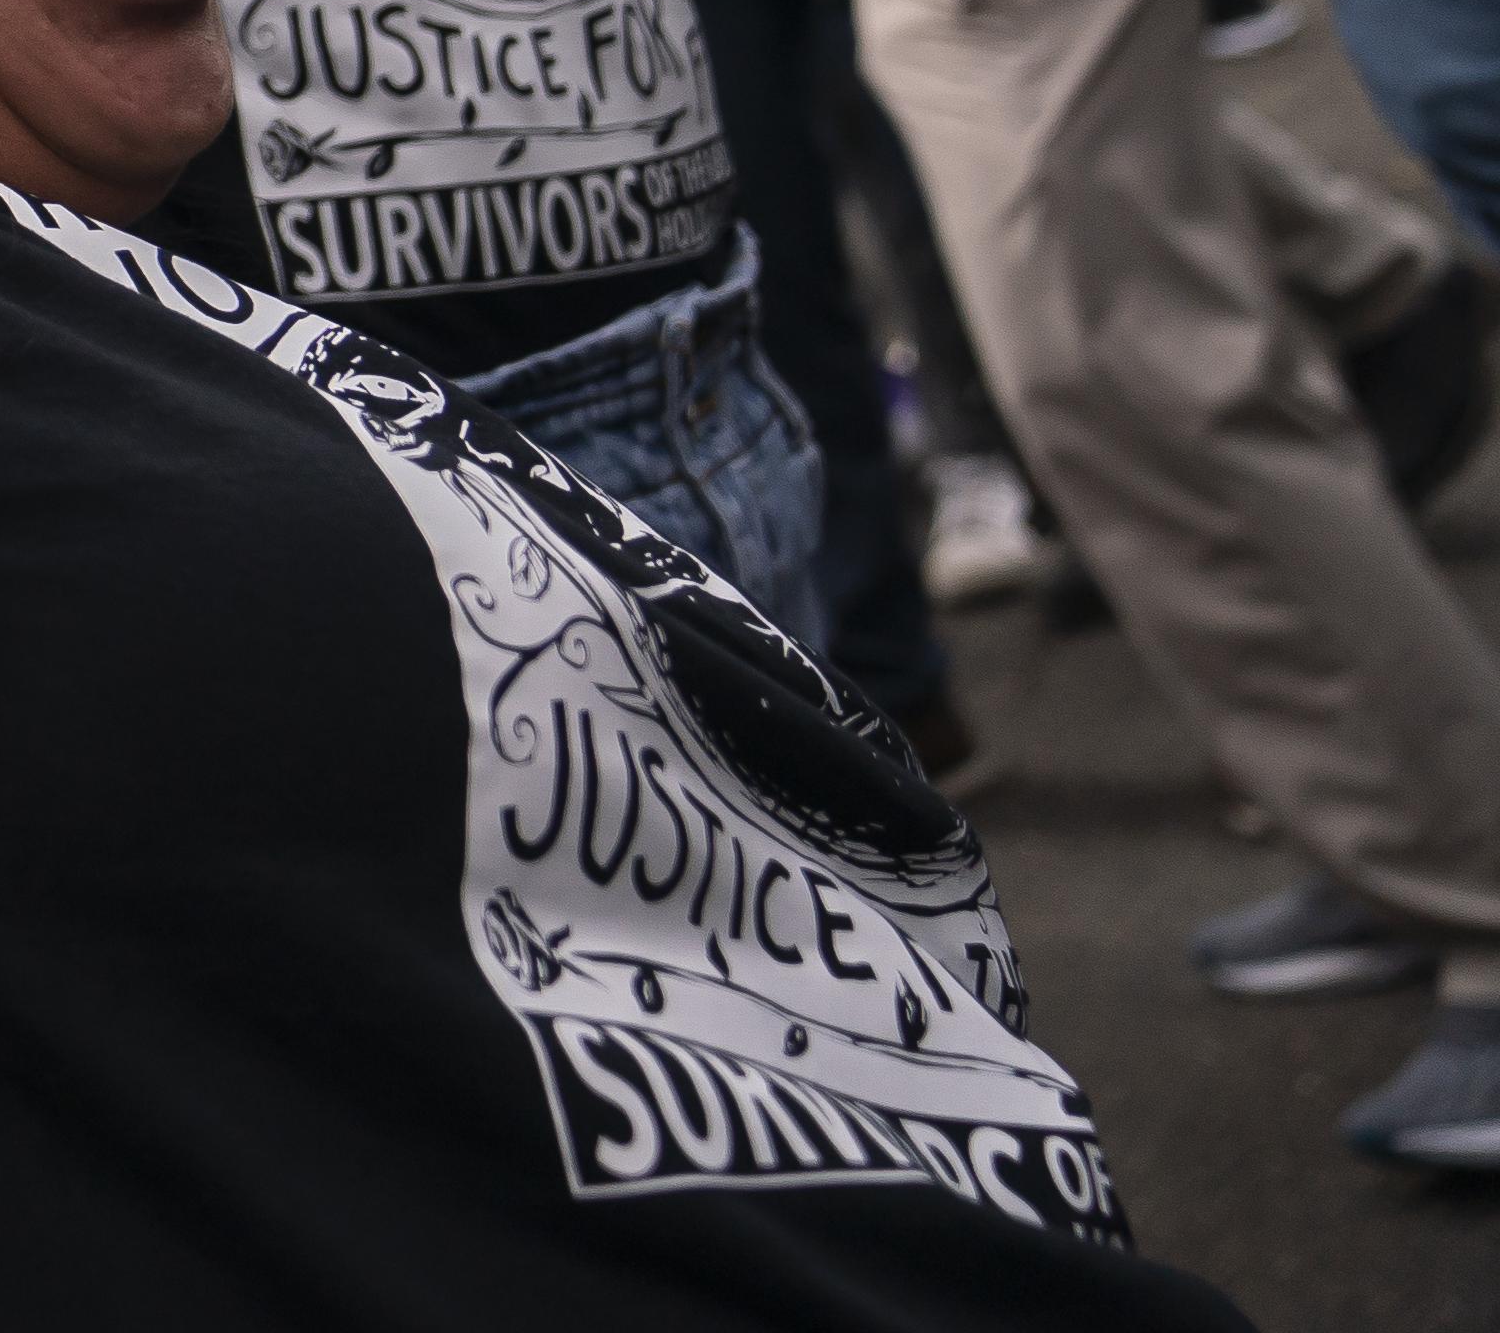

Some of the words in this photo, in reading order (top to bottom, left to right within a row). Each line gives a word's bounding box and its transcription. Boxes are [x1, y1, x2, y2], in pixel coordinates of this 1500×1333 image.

[258, 2, 568, 102] JUSTICE
[277, 165, 655, 294] SURVIVORS
[501, 697, 877, 980] JUSTICE
